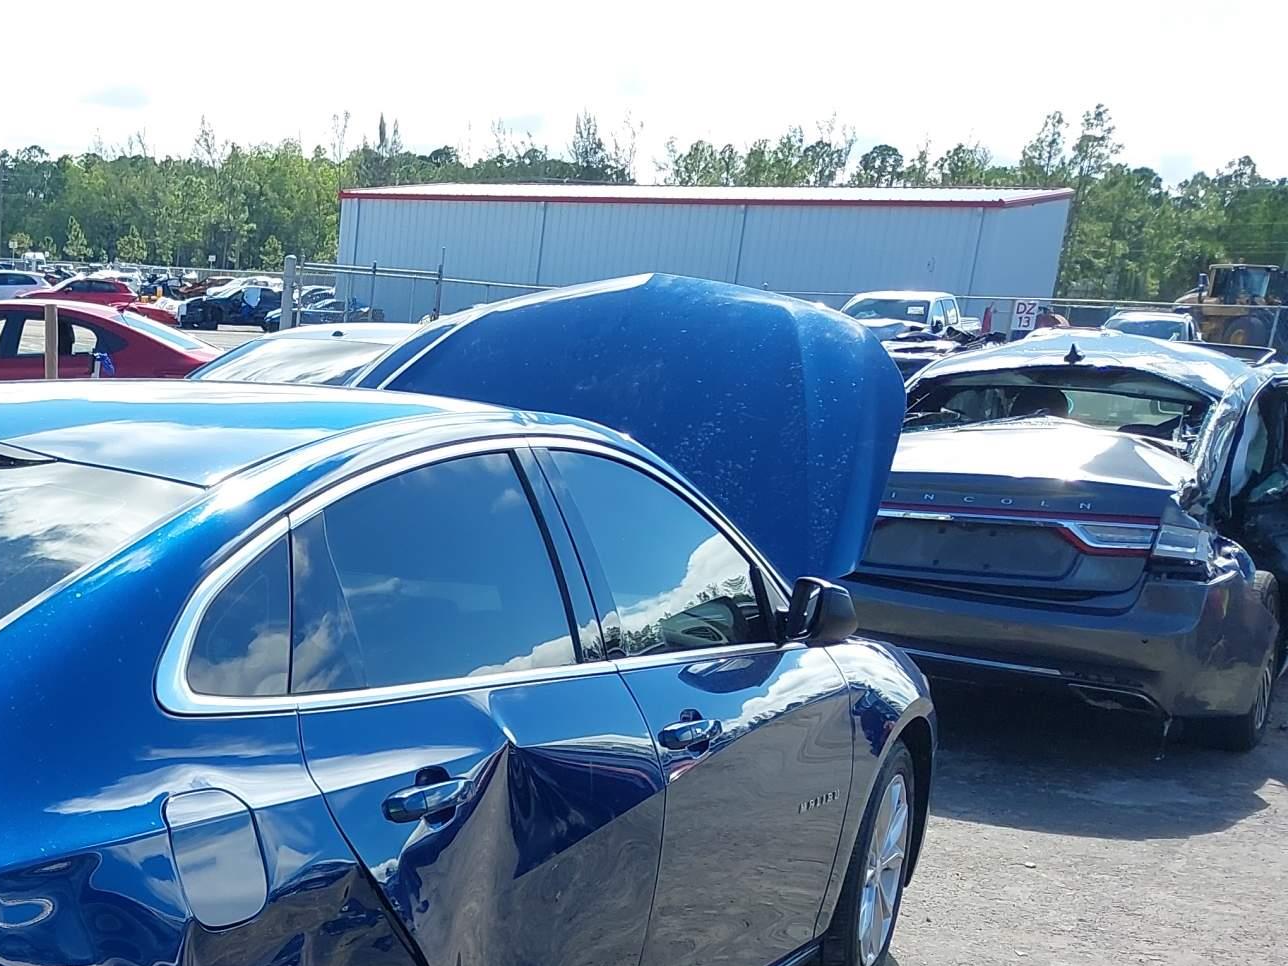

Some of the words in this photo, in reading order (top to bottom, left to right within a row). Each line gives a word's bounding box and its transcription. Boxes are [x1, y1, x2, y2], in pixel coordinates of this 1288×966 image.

[1015, 302, 1037, 315] DZ
[1017, 316, 1032, 328] 13
[890, 491, 1092, 511] INCOLN
